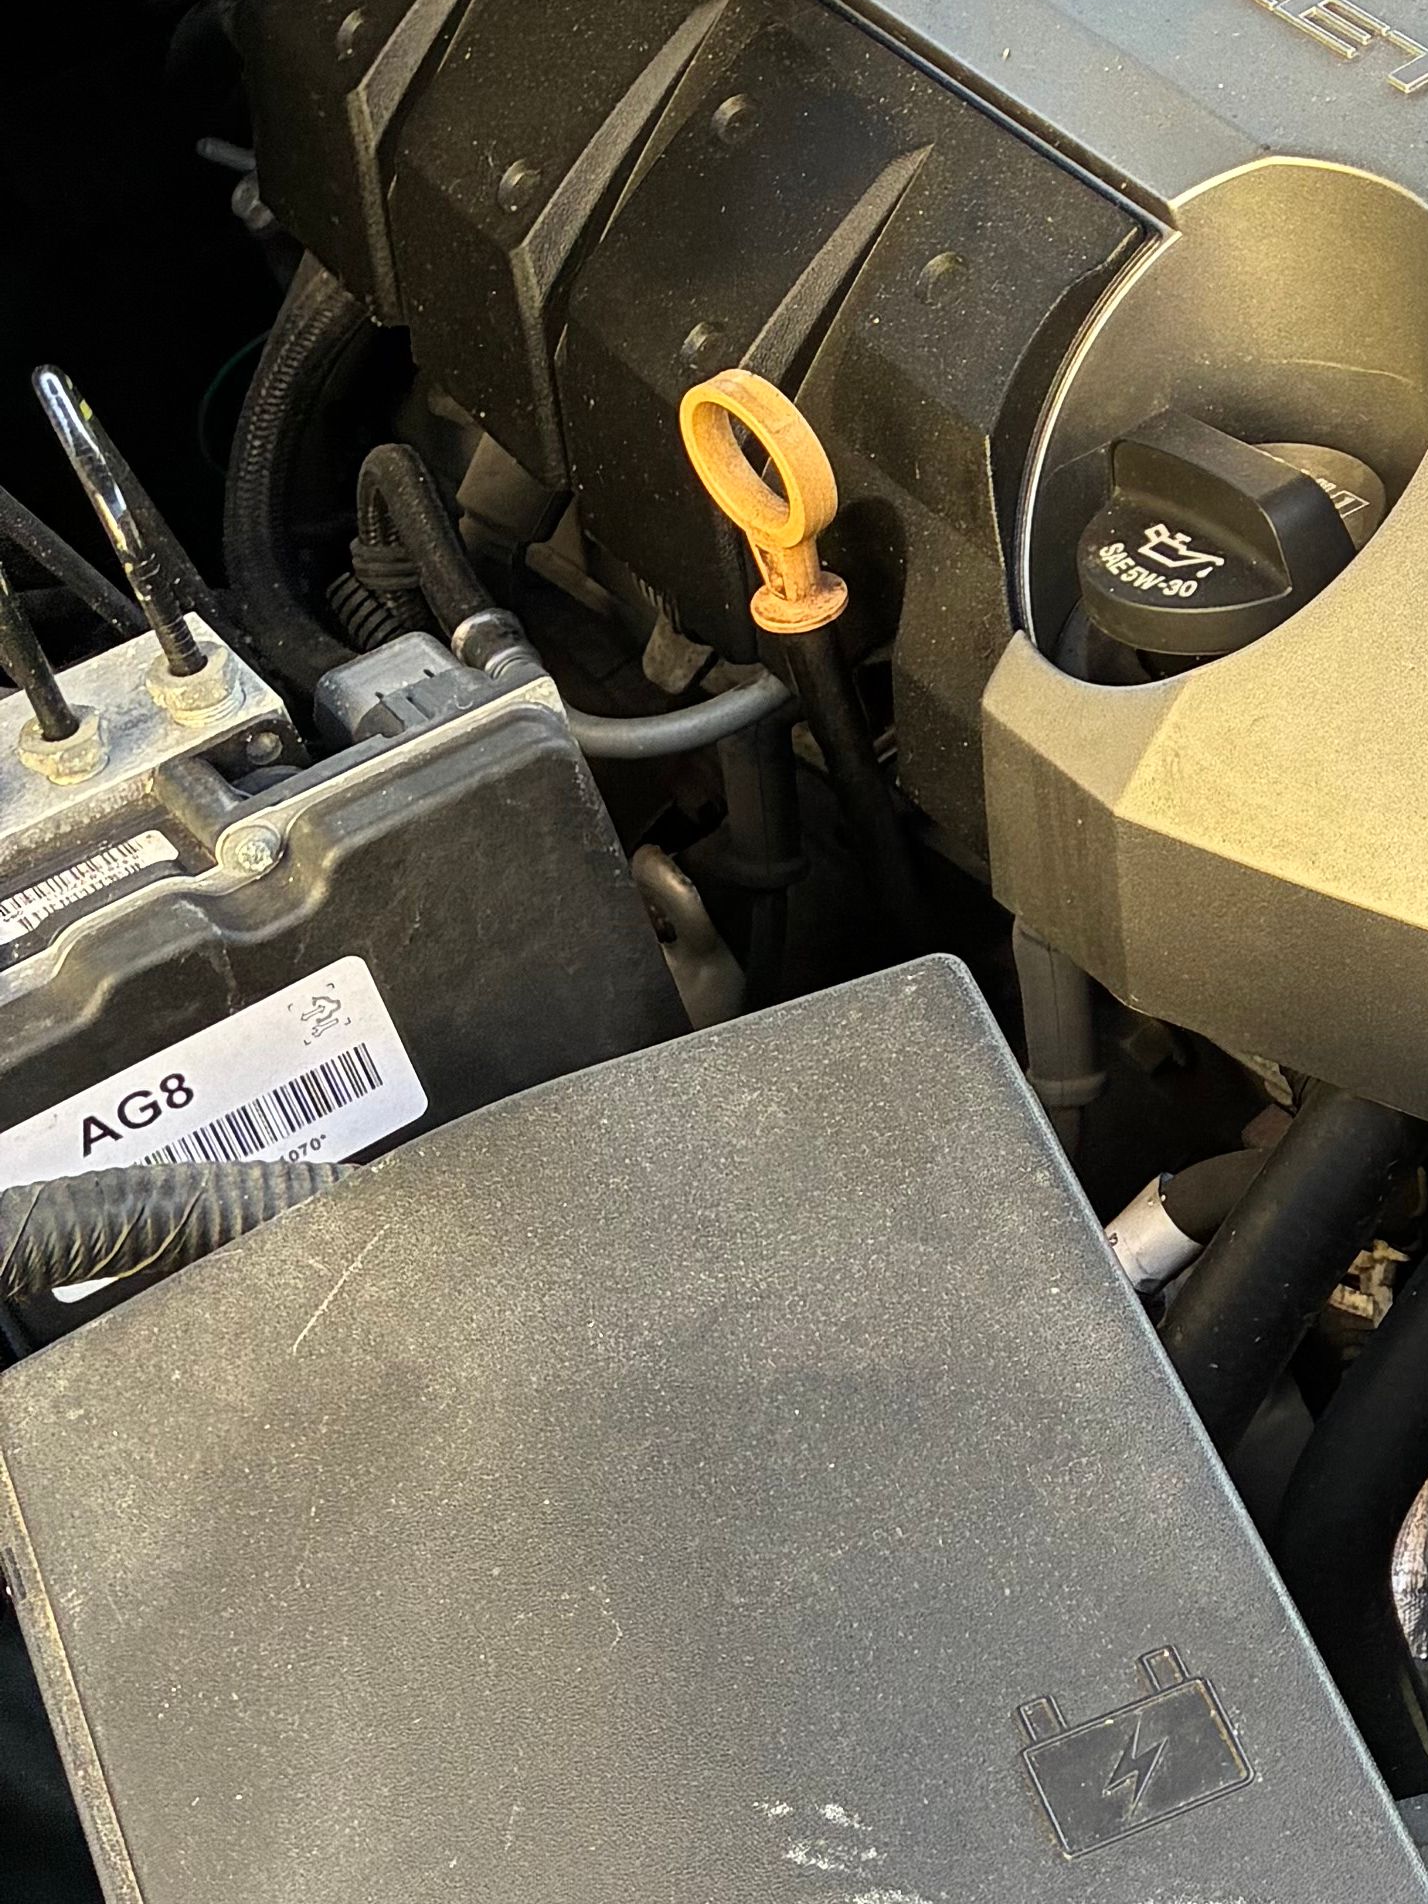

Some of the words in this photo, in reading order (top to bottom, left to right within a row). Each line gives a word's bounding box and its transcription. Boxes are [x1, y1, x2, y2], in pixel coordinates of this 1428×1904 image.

[1098, 542, 1136, 576] SAE
[1119, 565, 1199, 598] 5W-30
[80, 1072, 195, 1159] AG8
